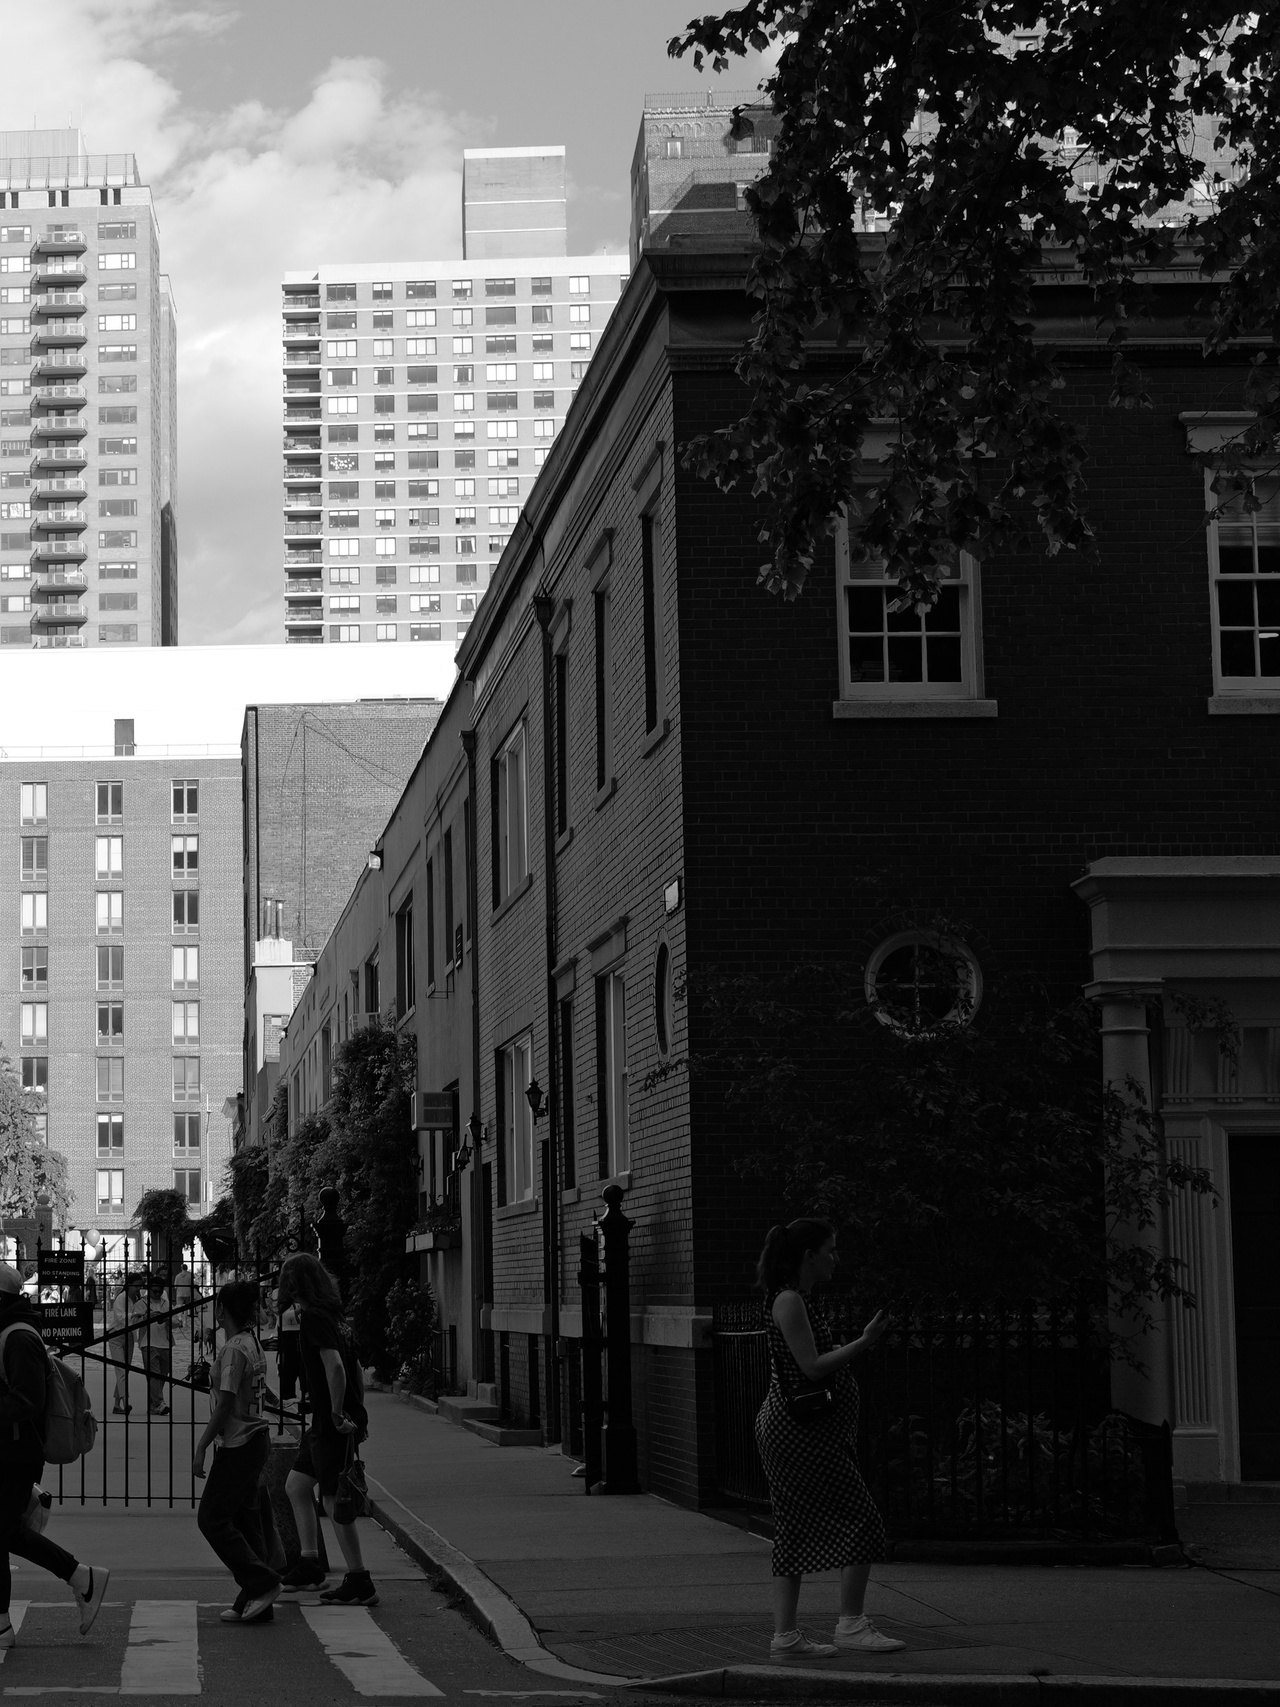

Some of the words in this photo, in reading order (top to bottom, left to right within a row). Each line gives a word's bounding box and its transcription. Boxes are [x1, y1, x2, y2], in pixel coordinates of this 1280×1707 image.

[44, 1308, 59, 1318] FIRE
[60, 1307, 77, 1317] LANE
[41, 1328, 51, 1338] NO
[52, 1327, 82, 1337] PARKING
